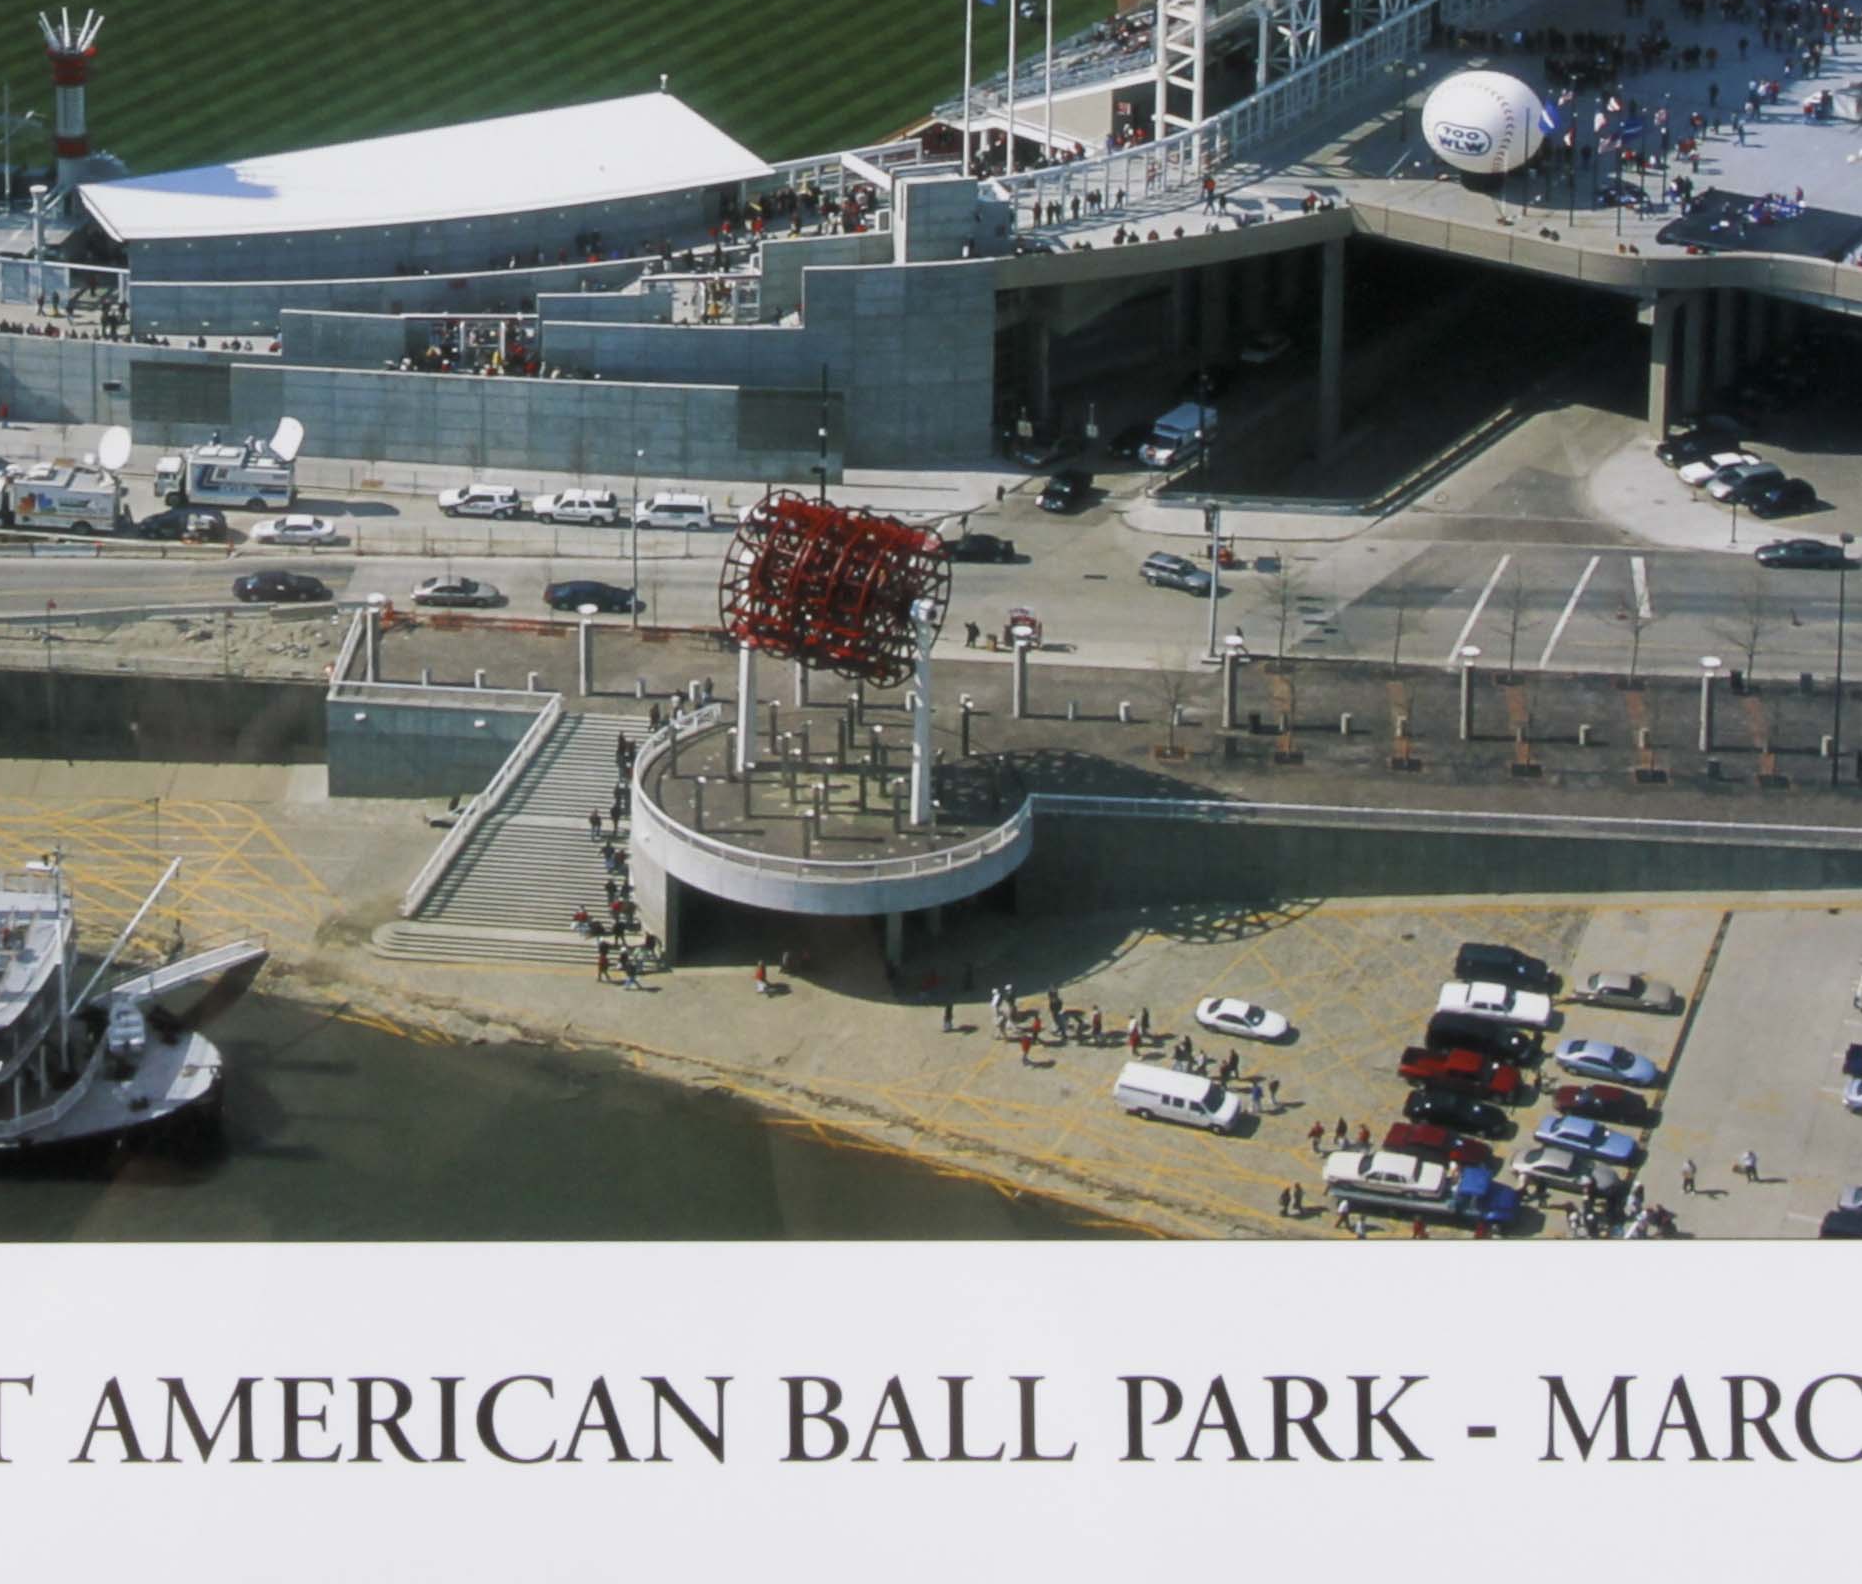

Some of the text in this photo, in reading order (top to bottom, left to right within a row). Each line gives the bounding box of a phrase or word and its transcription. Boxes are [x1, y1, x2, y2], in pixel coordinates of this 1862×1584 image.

[1442, 126, 1480, 141] 700
[1438, 135, 1486, 153] WLW
[70, 1376, 733, 1463] AMERICAN
[781, 1376, 1076, 1461] BALL
[1118, 1376, 1433, 1461] PARK
[1540, 1374, 1862, 1462] MARC
